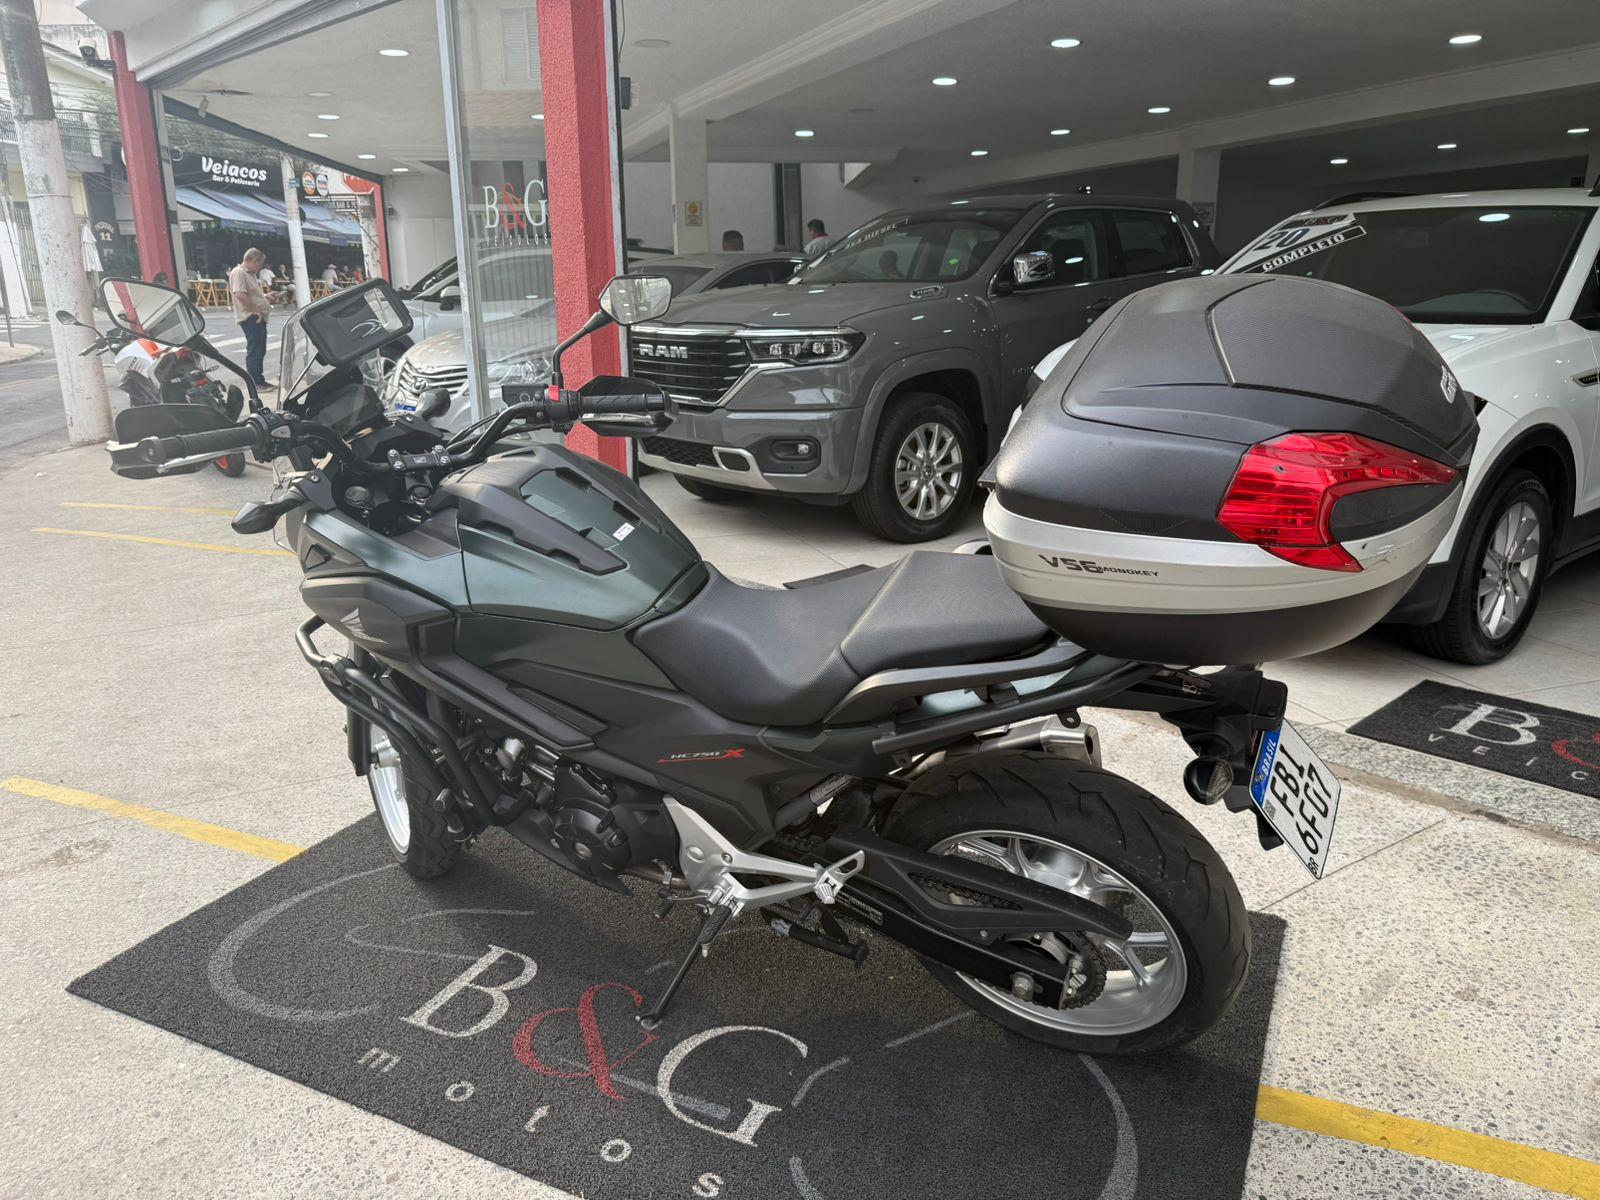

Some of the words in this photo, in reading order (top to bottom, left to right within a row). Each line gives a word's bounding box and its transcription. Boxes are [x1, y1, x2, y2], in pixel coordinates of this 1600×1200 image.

[202, 156, 267, 181] Veiacos
[212, 174, 224, 182] Bar
[482, 178, 547, 229] B&G
[1262, 234, 1346, 273] COMPLETO
[639, 344, 688, 359] RAM
[1038, 554, 1104, 574] V56
[1098, 566, 1160, 577] MONOKEY
[1261, 738, 1276, 776] BRASIL
[1270, 744, 1305, 818] FBI
[1296, 762, 1332, 855] 6F07
[399, 944, 808, 1147] B&G
[357, 1046, 726, 1199] motos
